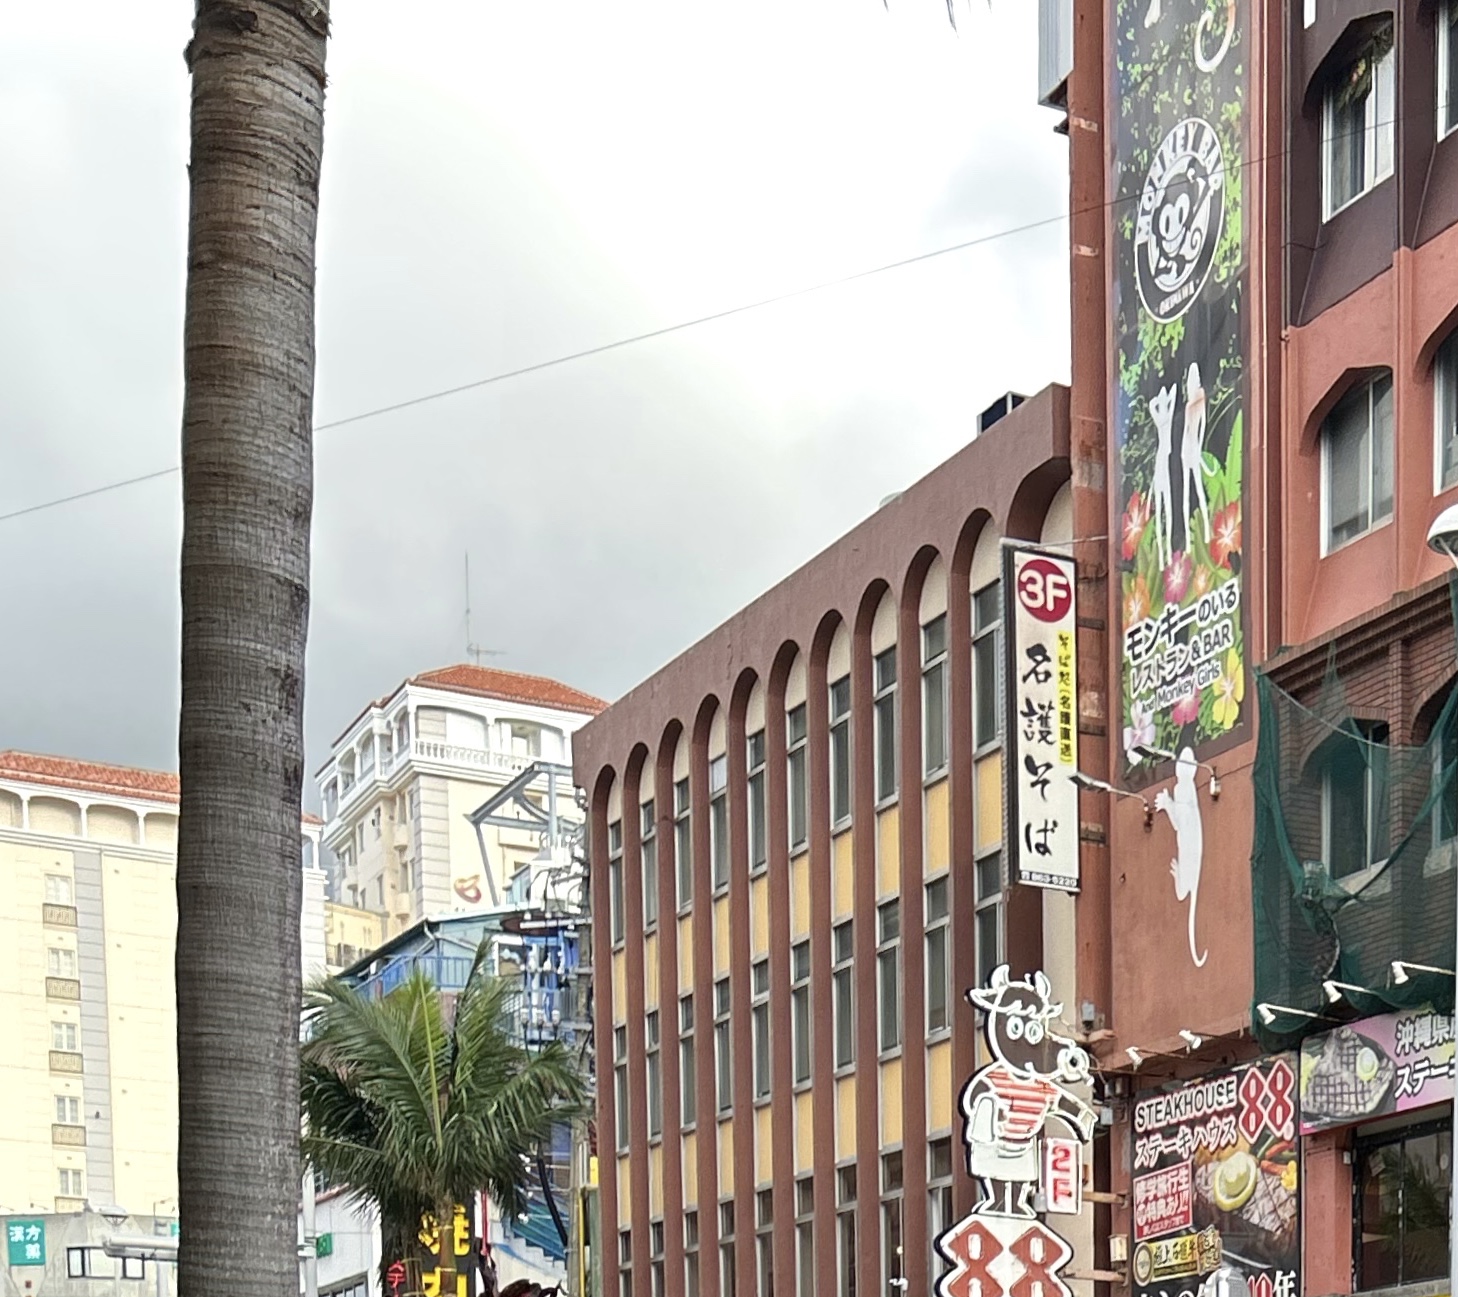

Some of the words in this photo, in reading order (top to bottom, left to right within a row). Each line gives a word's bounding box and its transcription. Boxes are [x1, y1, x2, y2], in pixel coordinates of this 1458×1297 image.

[1135, 121, 1200, 247] MONKEY
[1019, 568, 1069, 612] 3F
[1126, 582, 1238, 663] モンキーのいる
[1157, 677, 1195, 704] Monkey
[1197, 662, 1221, 686] Girls
[1020, 642, 1059, 858] 名護そば
[1136, 1078, 1236, 1130] STEAKHOUSE
[1240, 1061, 1293, 1143] 88
[1134, 1117, 1237, 1168] ステーキハウス
[9, 1224, 42, 1242] 漢方
